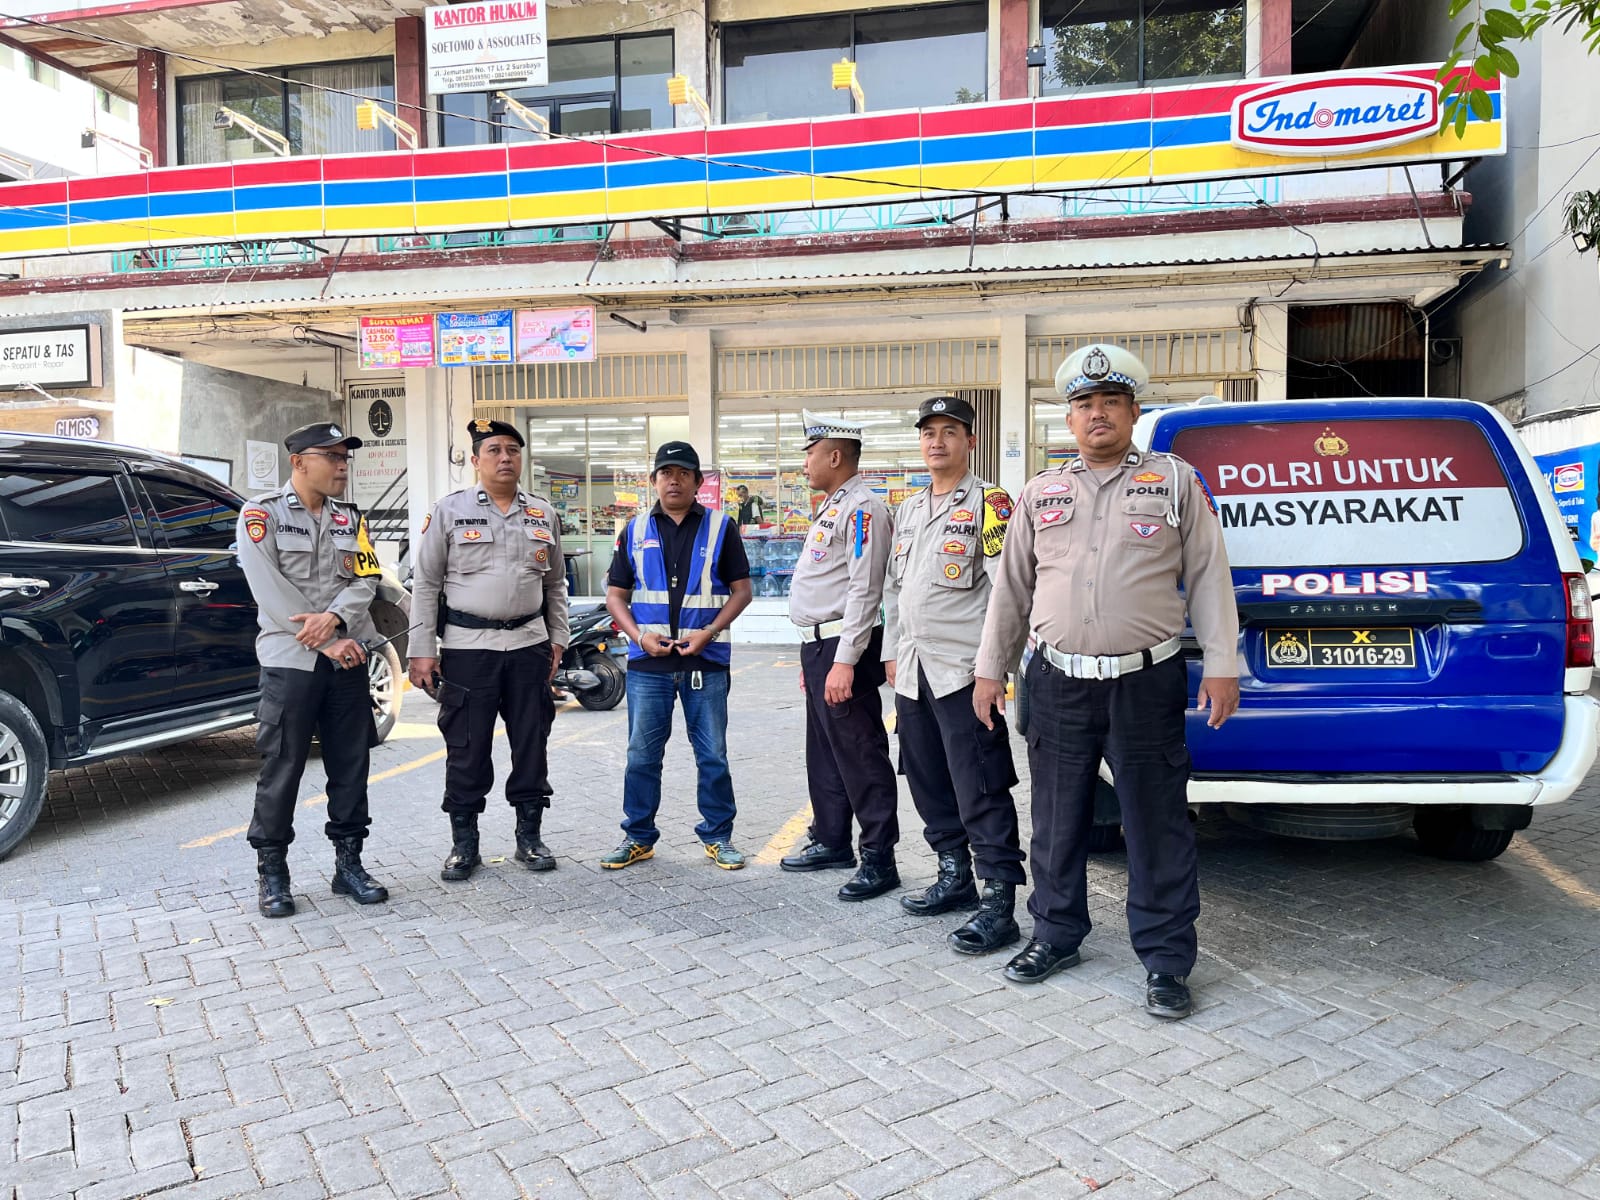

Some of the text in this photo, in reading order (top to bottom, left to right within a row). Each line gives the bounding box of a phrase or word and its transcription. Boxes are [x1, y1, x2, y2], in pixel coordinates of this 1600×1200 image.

[434, 1, 537, 27] KANTOR HUKUM
[431, 32, 542, 54] SOETOMO & ASSOCIATES
[1247, 92, 1427, 133] Indomaret
[396, 316, 424, 326] HEMAT
[3, 343, 74, 361] SEPATU & TAS
[351, 388, 380, 400] KANTOR
[56, 419, 93, 437] GLMGS
[1217, 456, 1459, 490] POLRI UNTUK
[1126, 486, 1169, 497] POLRI
[1035, 496, 1074, 509] SETYO
[1220, 495, 1464, 529] MASYARAKAT
[523, 518, 550, 528] POLRI
[943, 523, 976, 536] POLRI
[1261, 570, 1428, 596] POLISI
[1351, 630, 1372, 644] X
[1321, 647, 1406, 665] 31016-29
